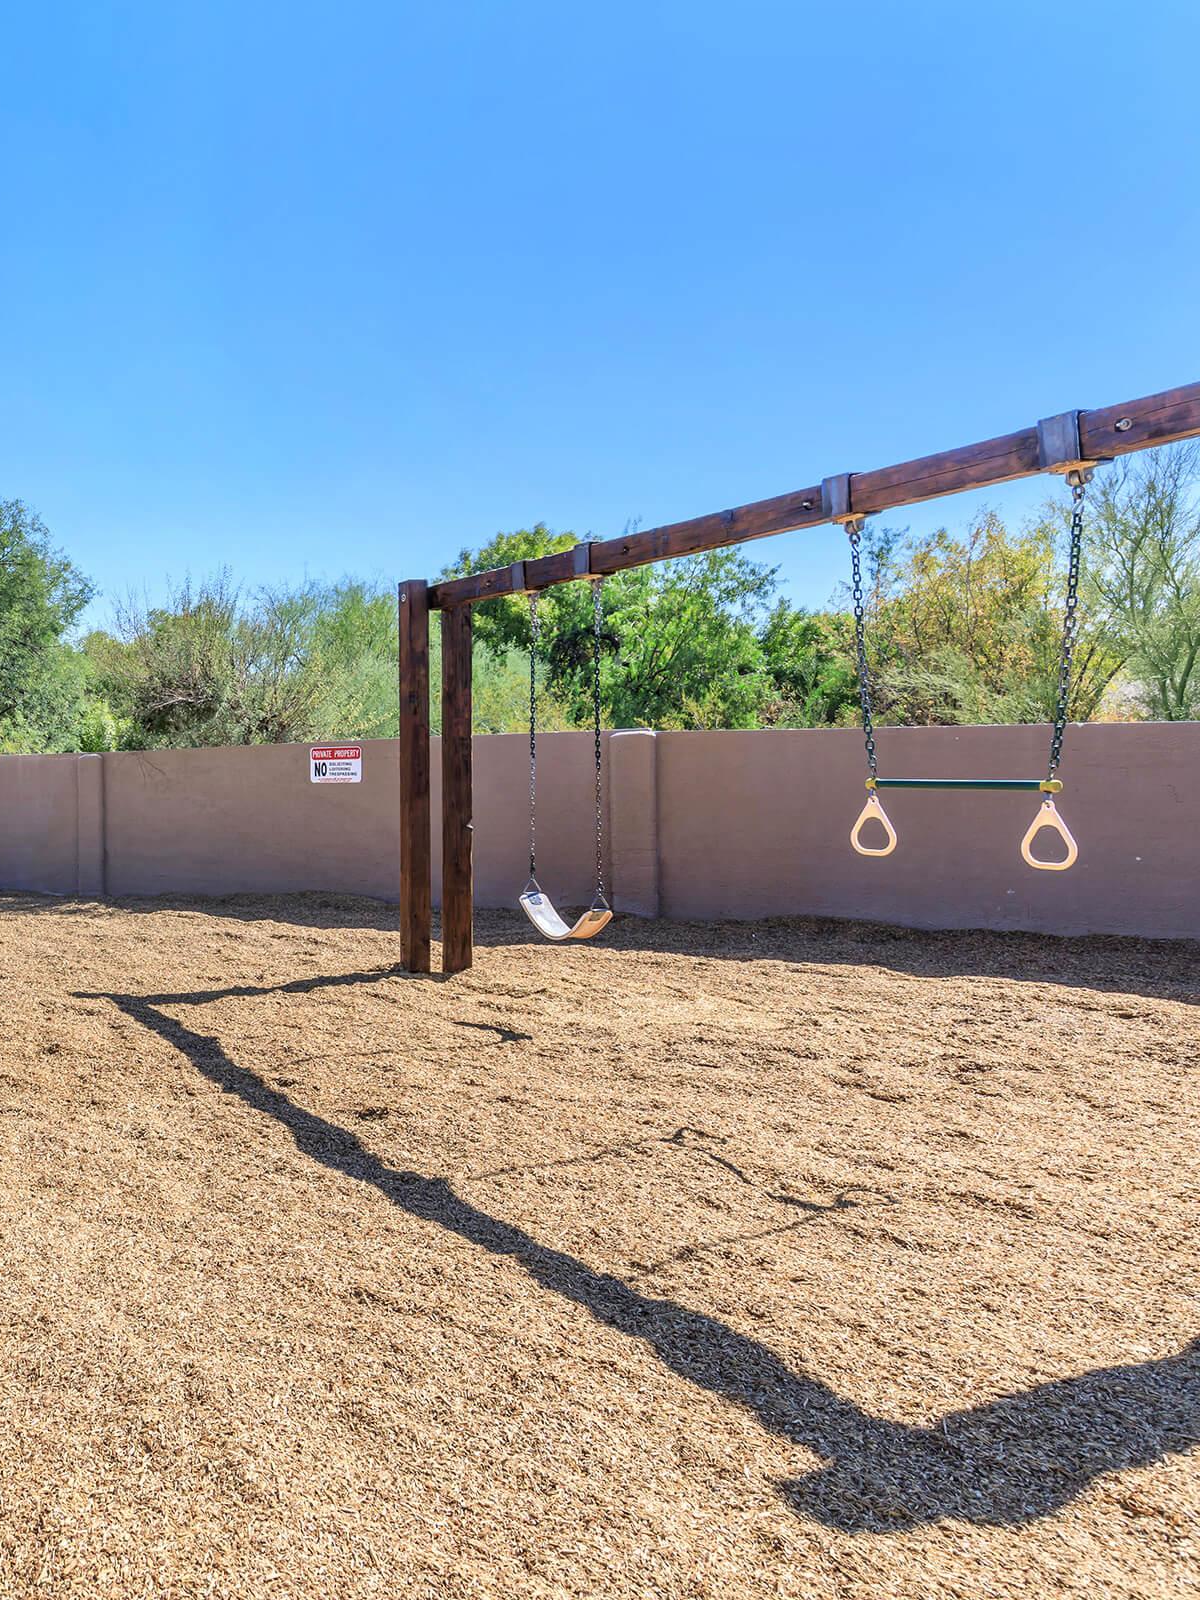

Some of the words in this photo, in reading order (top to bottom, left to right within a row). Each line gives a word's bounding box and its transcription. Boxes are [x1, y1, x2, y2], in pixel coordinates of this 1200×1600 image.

[312, 750, 332, 758] PRIVATE
[334, 749, 359, 758] PROPERTY
[314, 762, 327, 776] NO
